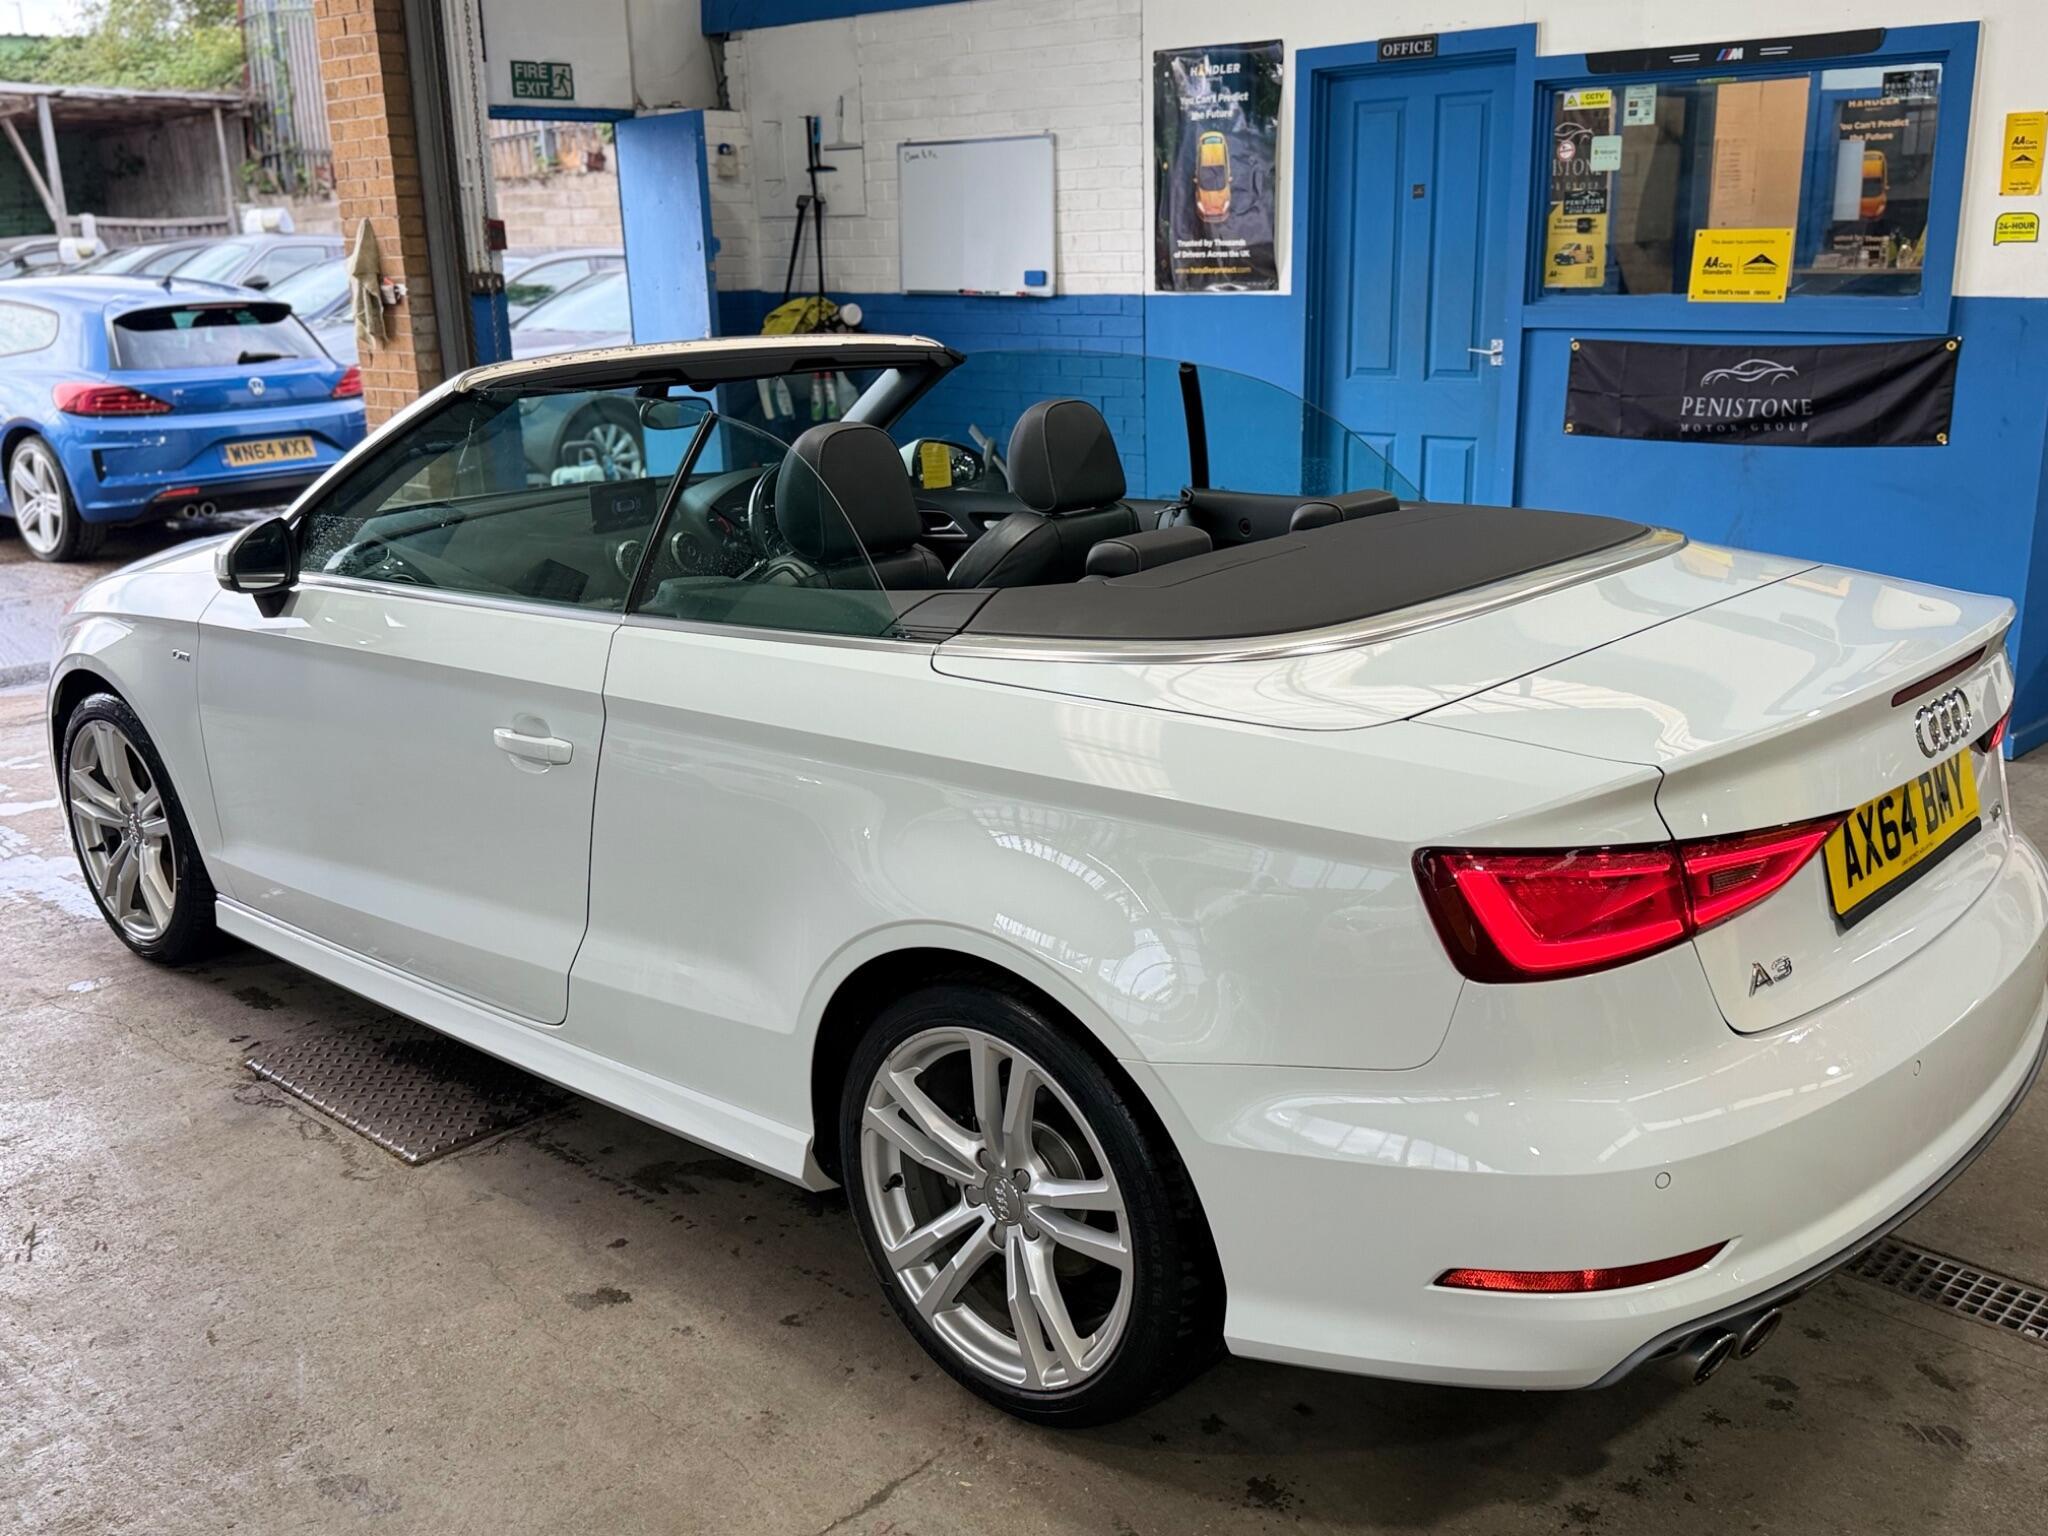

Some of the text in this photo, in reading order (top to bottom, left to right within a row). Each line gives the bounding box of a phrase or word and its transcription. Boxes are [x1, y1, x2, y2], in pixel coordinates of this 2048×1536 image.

[1382, 40, 1433, 57] OFFICE
[514, 63, 548, 79] FIRE
[1190, 63, 1242, 77] HANDLER
[516, 81, 550, 97] EXIT
[1218, 91, 1249, 102] Predict
[1585, 92, 1605, 101] CCTV
[1206, 109, 1233, 119] Future
[1854, 120, 1876, 130] Can't
[1877, 118, 1909, 128] Predict
[1865, 133, 1893, 141] Future
[1998, 222, 2036, 231] 24-HOUR
[1177, 239, 1203, 248] Trusted
[1203, 240, 1214, 248] by
[1173, 249, 1251, 259] of Drivers Across the UK
[1703, 256, 1733, 269] AA Cars
[1680, 396, 1814, 419] PENISTONE
[1680, 422, 1809, 433] MOTOR GROUP
[229, 439, 313, 464] WN64 WXA
[1843, 752, 1964, 889] AX64 BMY
[1749, 956, 1793, 998] A3
